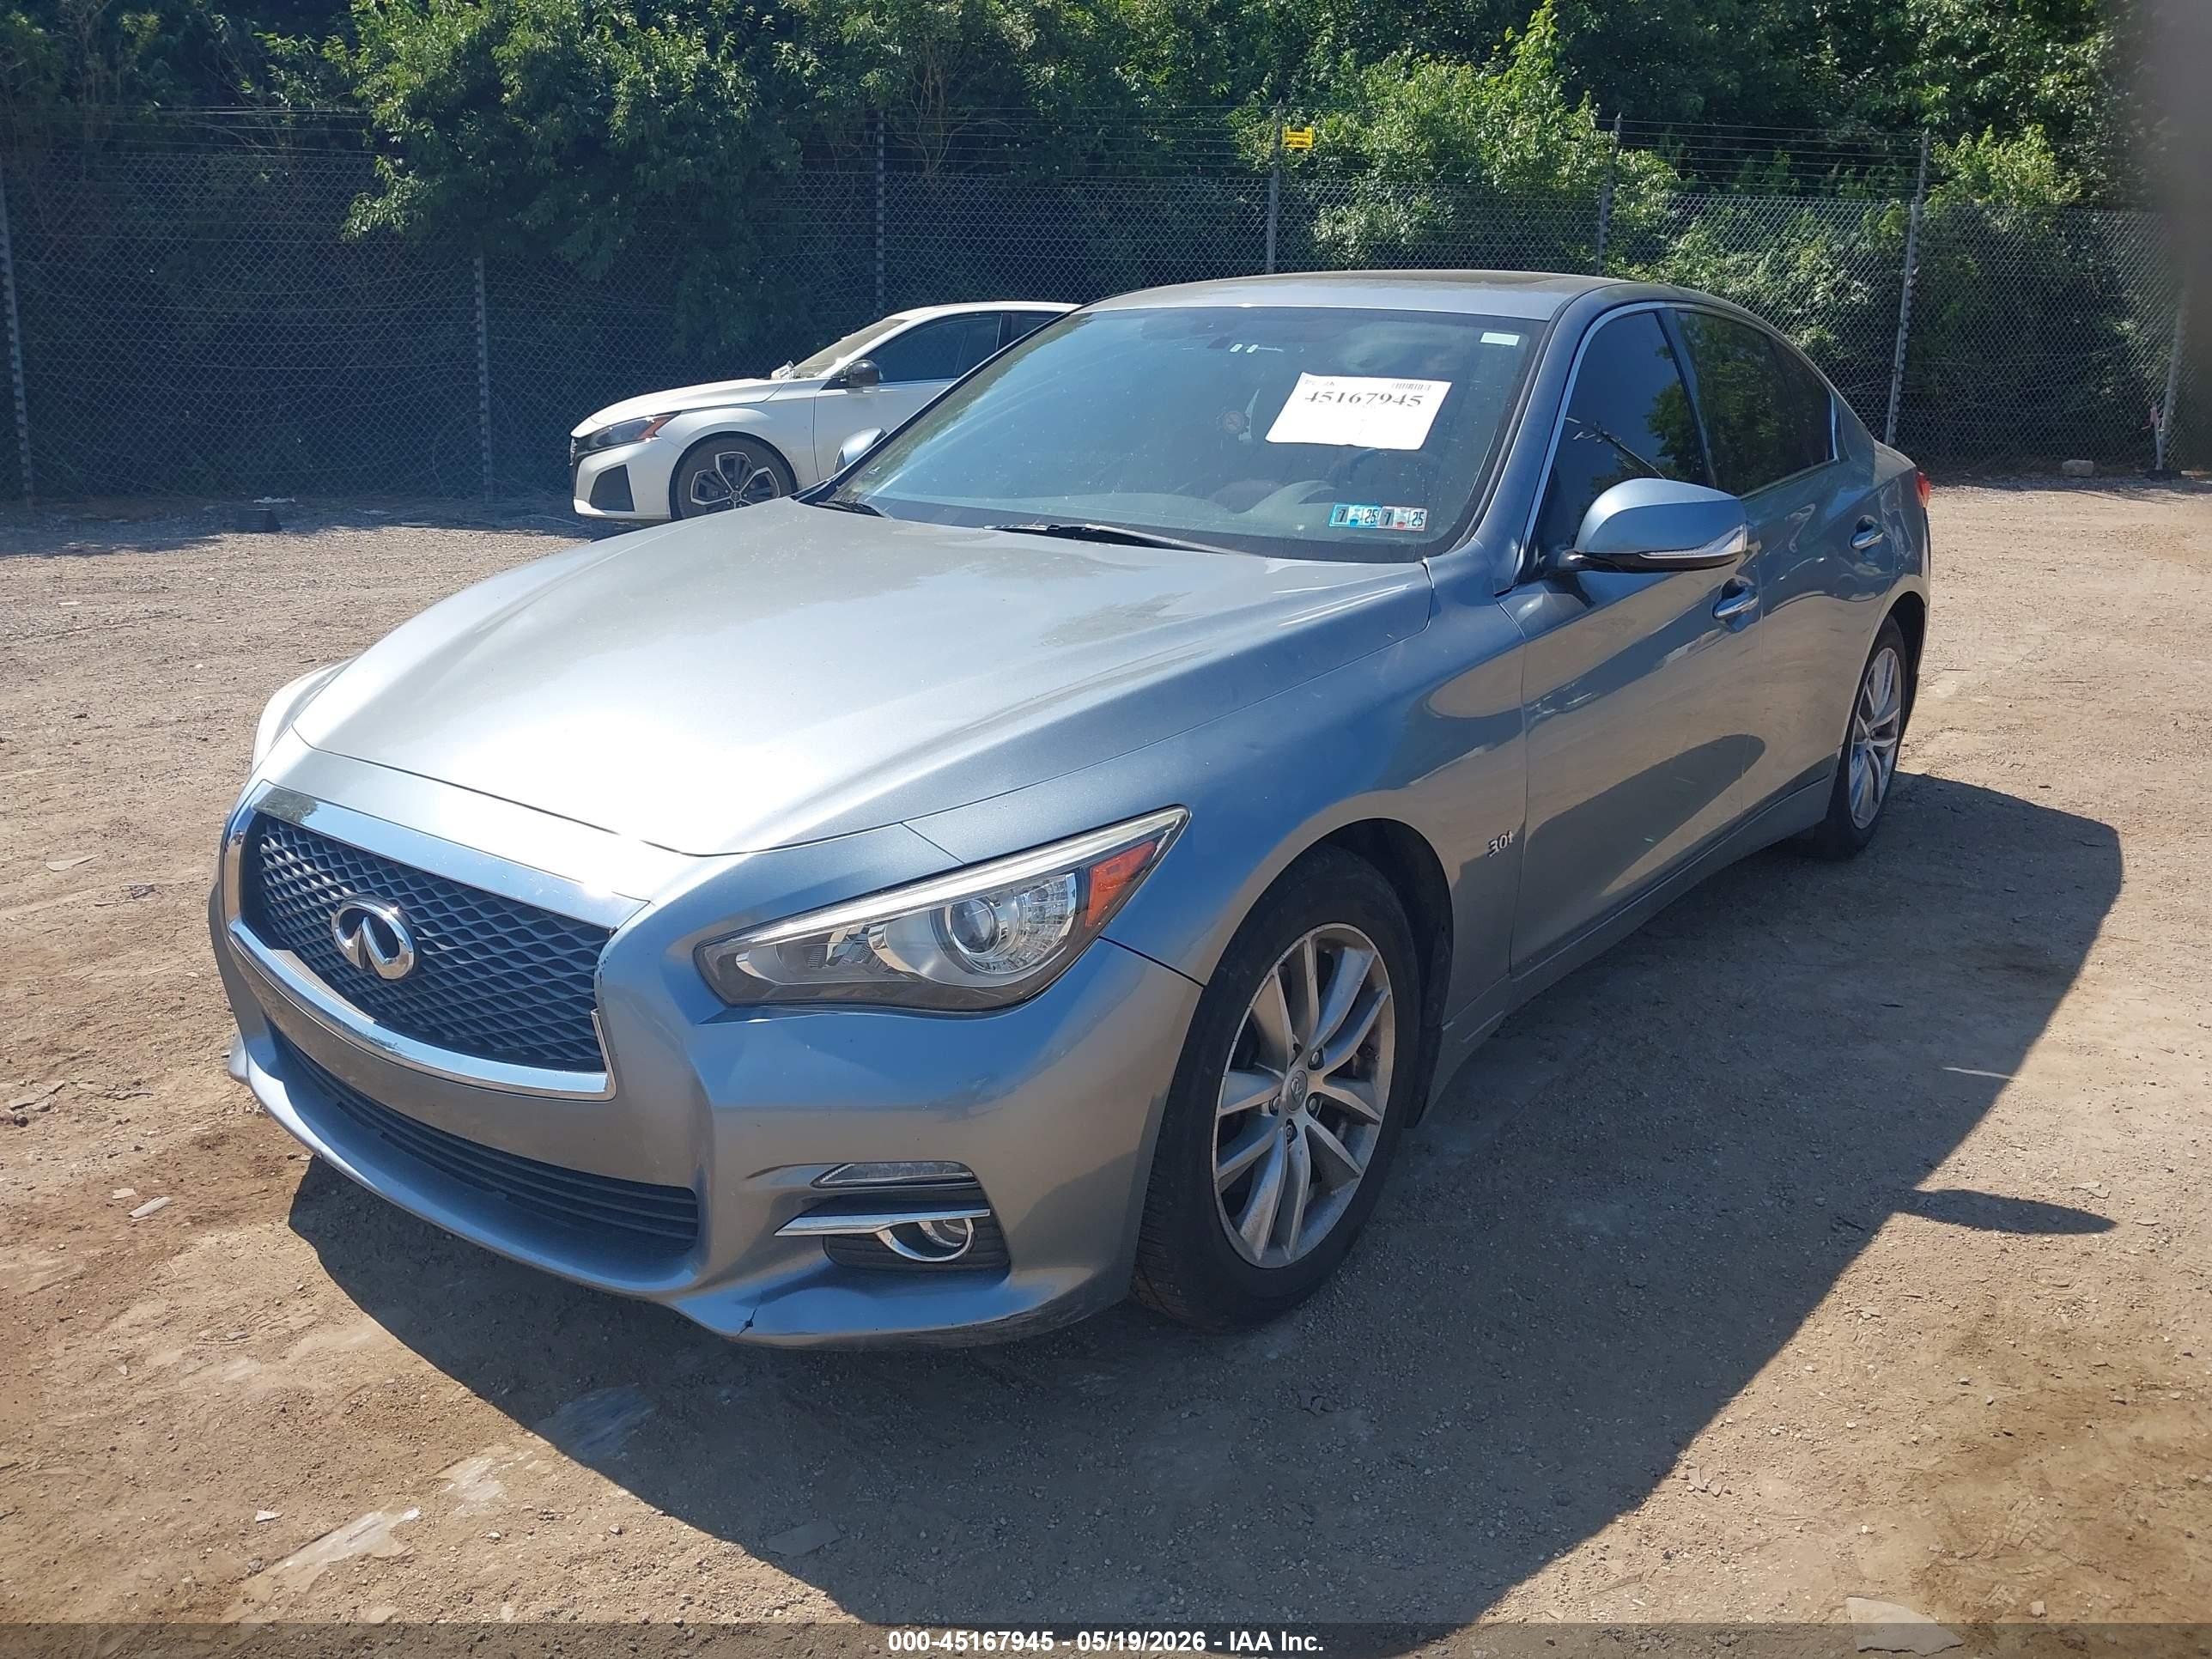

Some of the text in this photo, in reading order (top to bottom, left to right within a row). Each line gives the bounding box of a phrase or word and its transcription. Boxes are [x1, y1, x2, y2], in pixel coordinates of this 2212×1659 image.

[1304, 391, 1424, 407] 45167945
[1364, 508, 1378, 524] 25
[1411, 511, 1425, 526] 25
